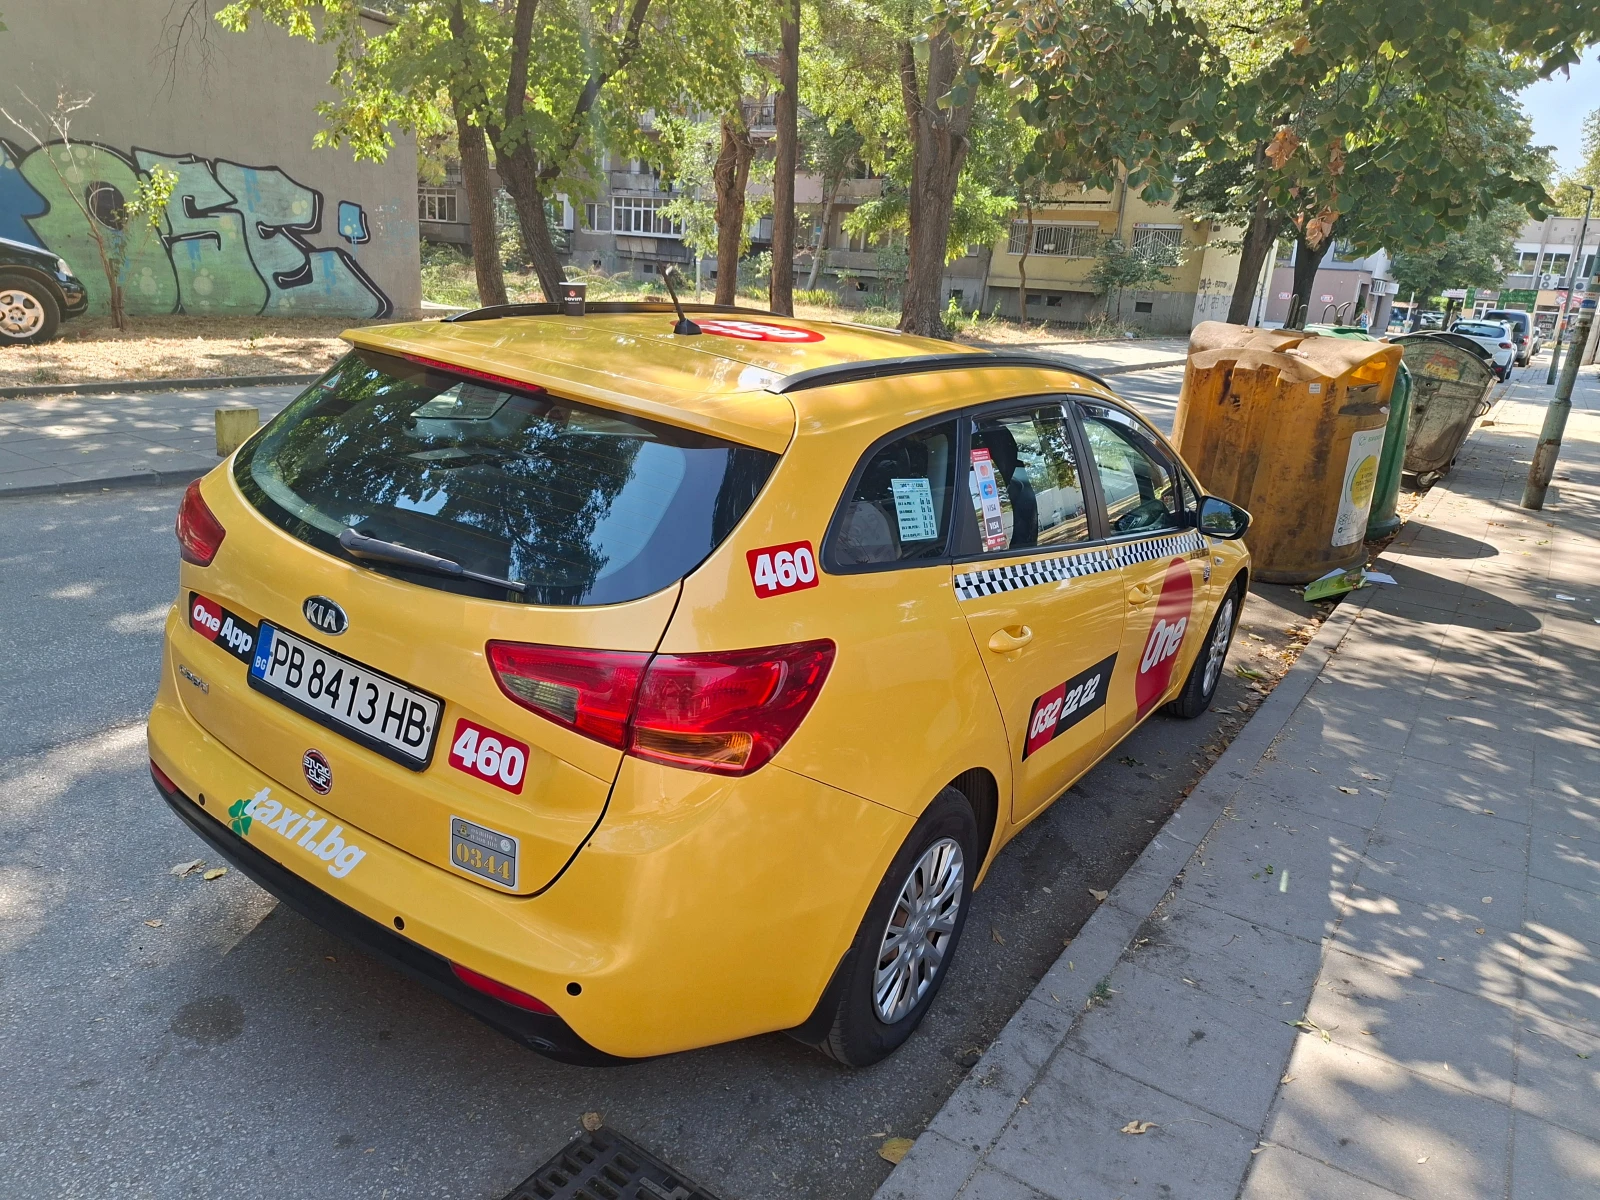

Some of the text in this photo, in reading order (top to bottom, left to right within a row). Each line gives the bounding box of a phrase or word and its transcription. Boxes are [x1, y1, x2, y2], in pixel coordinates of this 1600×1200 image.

[986, 503, 997, 512] VISA
[988, 521, 1000, 531] VISA
[754, 547, 816, 591] 460
[193, 604, 253, 654] One App
[306, 599, 338, 631] KIA
[254, 655, 267, 671] BG
[1140, 616, 1187, 674] One
[269, 637, 428, 748] PB 8413 HB
[1030, 673, 1101, 740] 032 22 22
[452, 727, 525, 786] 460
[243, 787, 367, 879] taxi1.bg
[456, 842, 510, 880] 0344
